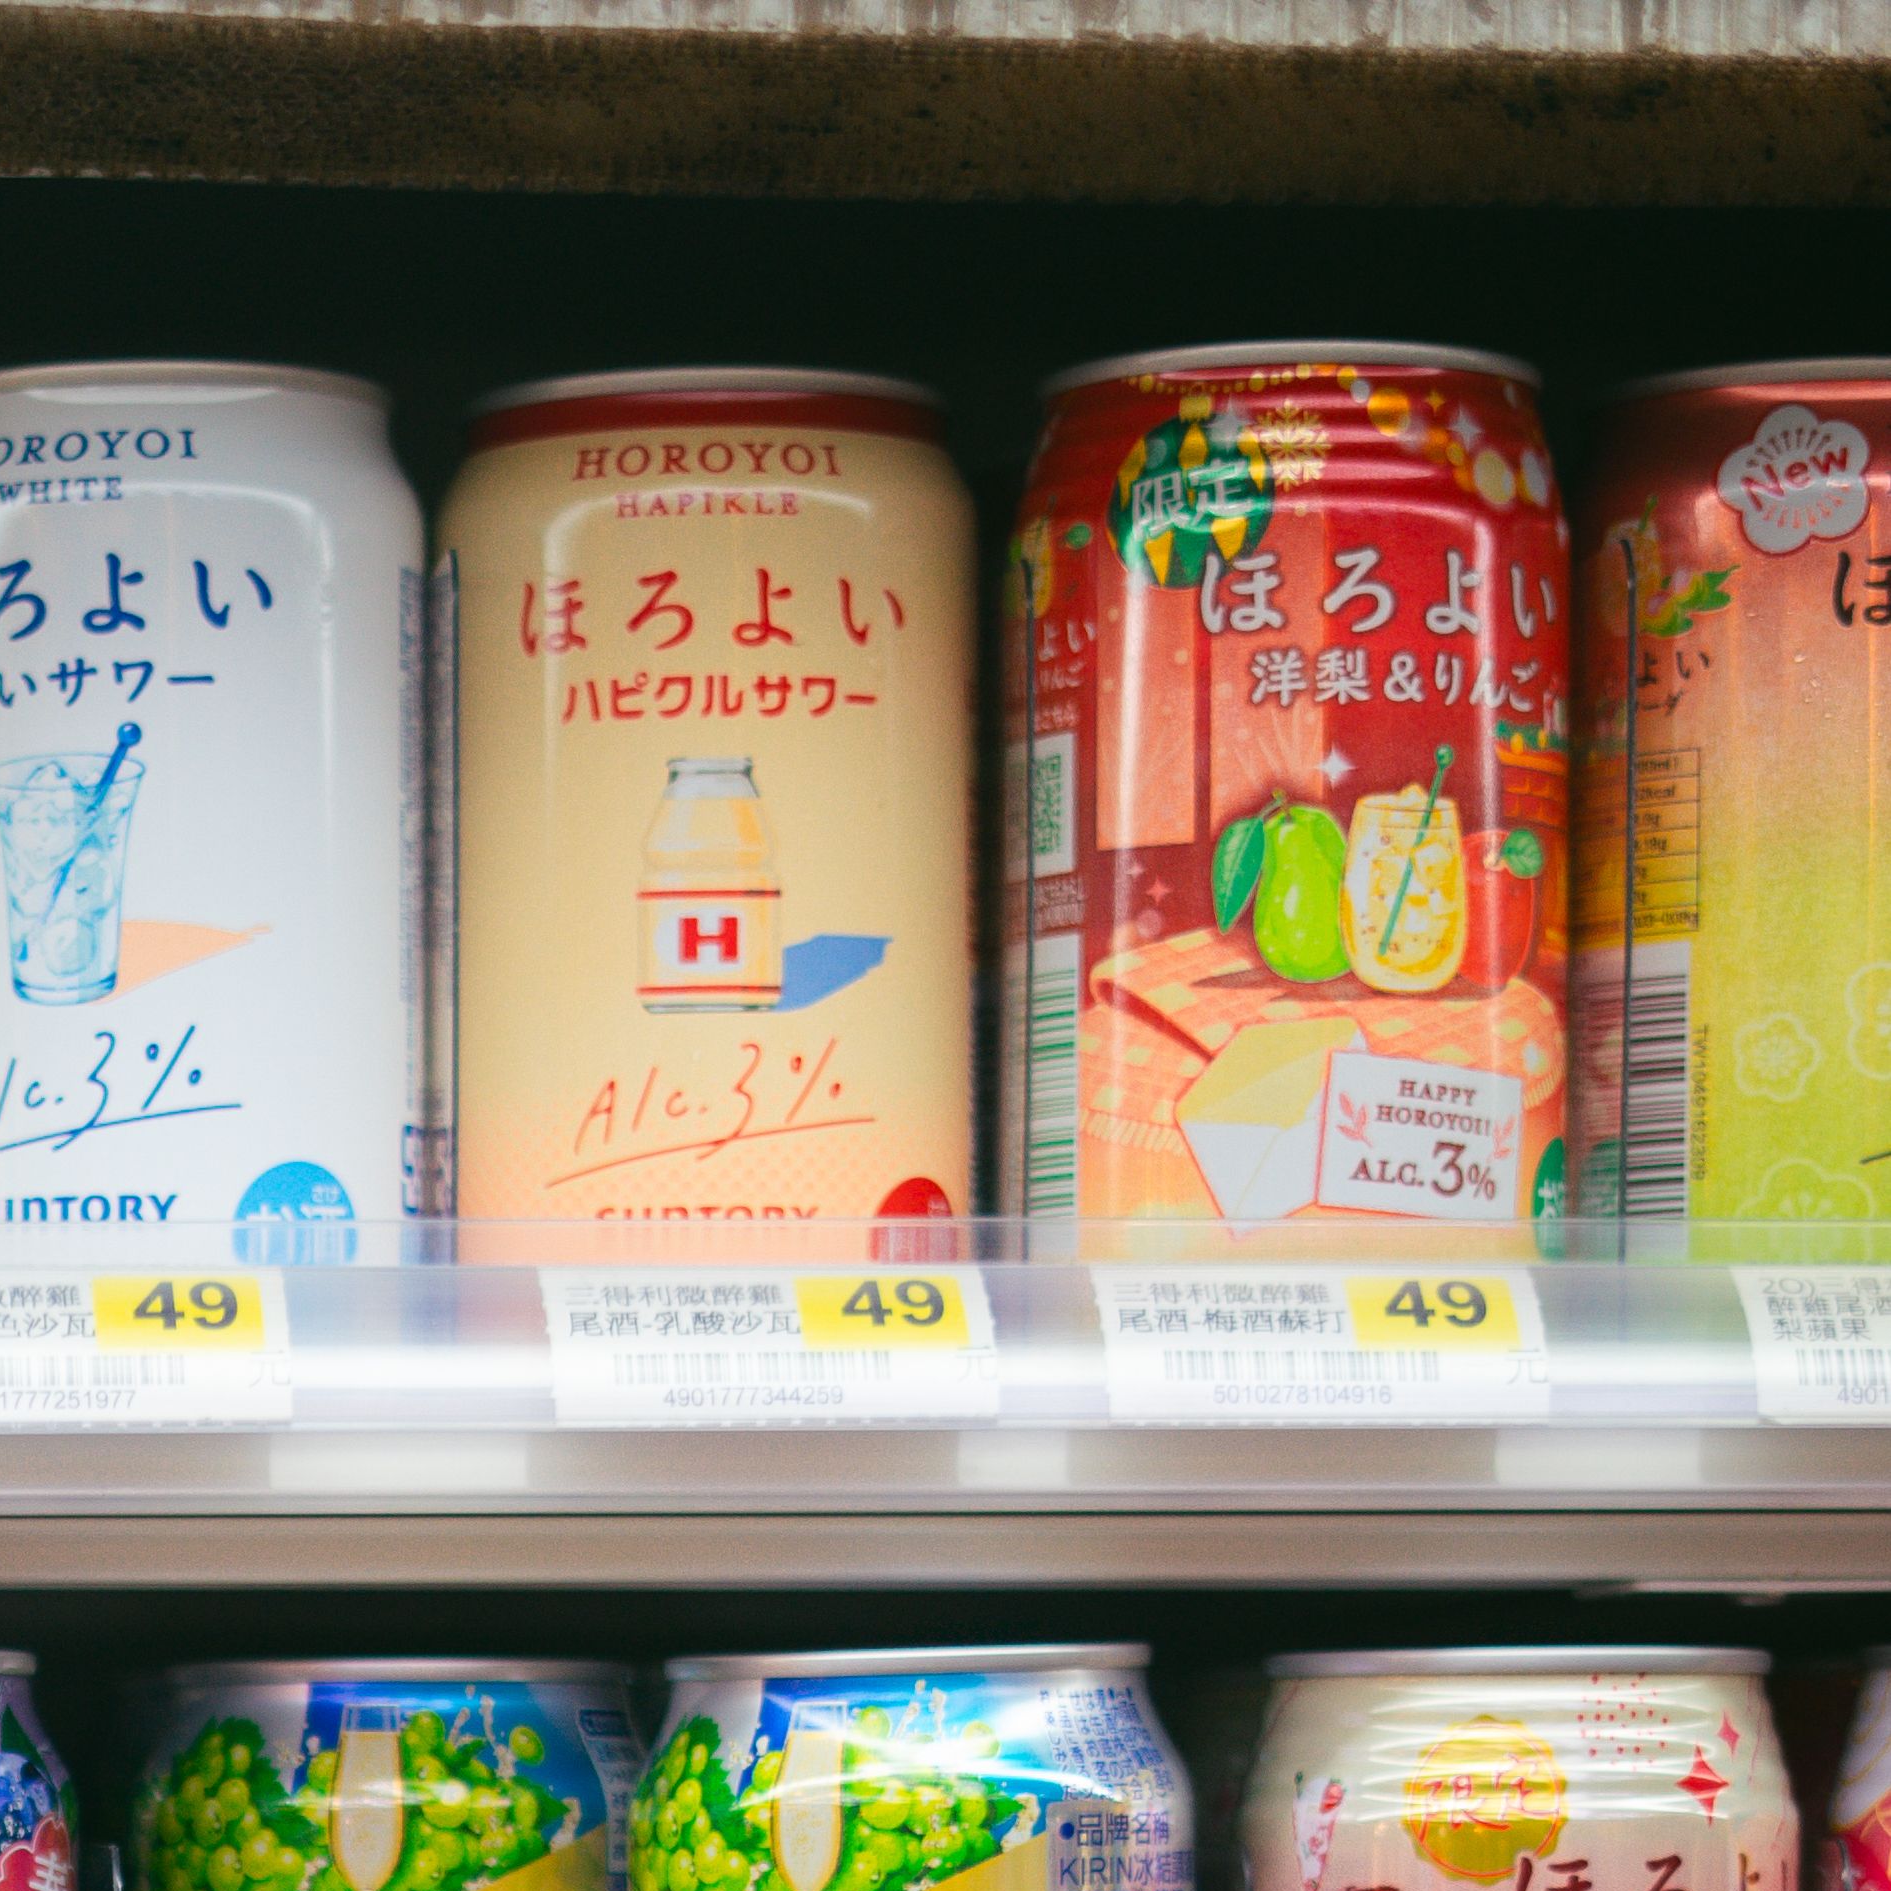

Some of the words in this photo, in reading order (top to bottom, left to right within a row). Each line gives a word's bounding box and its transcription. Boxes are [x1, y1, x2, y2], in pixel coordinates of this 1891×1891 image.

[572, 441, 843, 480] HOROYOI
[1744, 444, 1851, 512] New
[615, 489, 801, 520] HAPIKLE
[1130, 452, 1256, 541] 限定
[520, 568, 907, 661] ほろよい
[1199, 548, 1558, 638] ほろよい
[560, 673, 878, 725] ハピクルサワー
[1397, 1078, 1478, 1109] HAPPY
[132, 1279, 240, 1332] 49
[839, 1278, 946, 1328] 49
[1384, 1279, 1489, 1330] 49
[662, 1386, 845, 1408] 4901777344259
[1415, 1750, 1562, 1838] 限定
